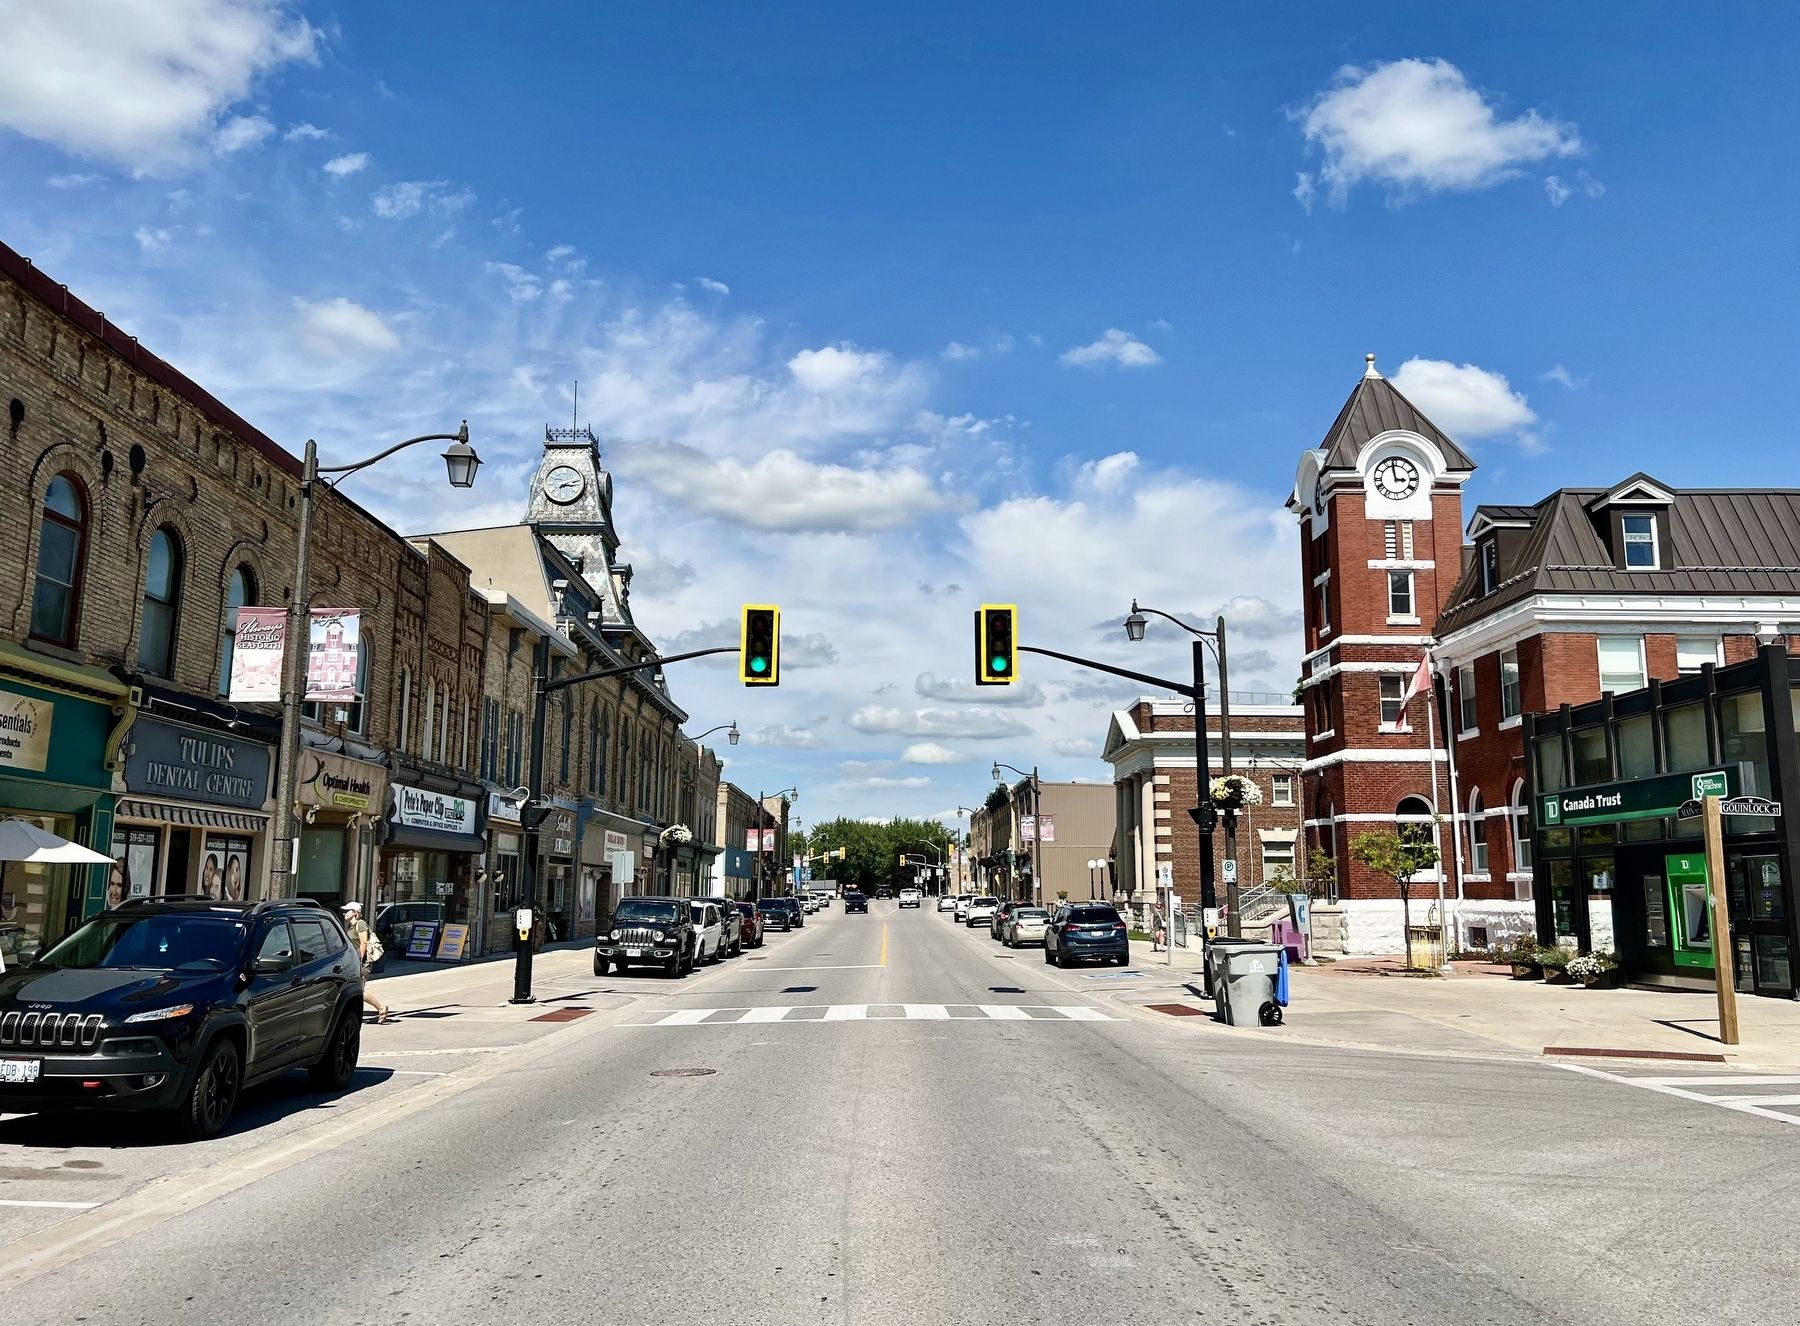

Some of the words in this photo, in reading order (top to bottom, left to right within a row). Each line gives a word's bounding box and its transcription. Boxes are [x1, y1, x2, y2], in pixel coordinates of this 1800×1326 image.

[236, 617, 284, 635] Always
[240, 633, 280, 641] HISTORIC
[180, 736, 235, 770] TULIPS
[145, 762, 201, 791] DENTAL
[206, 773, 255, 799] CENTRE
[323, 772, 350, 791] Optimal
[350, 778, 371, 796] Health
[405, 790, 419, 811] Pete's
[420, 793, 434, 818] Paper
[434, 796, 445, 820] Clip
[1546, 802, 1558, 818] TD
[1563, 795, 1595, 812] Canada
[1596, 792, 1622, 808] Trust
[1722, 804, 1770, 814] GOUINLOCK
[411, 817, 429, 827] COMPUTER
[432, 820, 443, 829] OFFICE
[443, 821, 458, 831] SUPPLIES
[1681, 860, 1689, 870] TD
